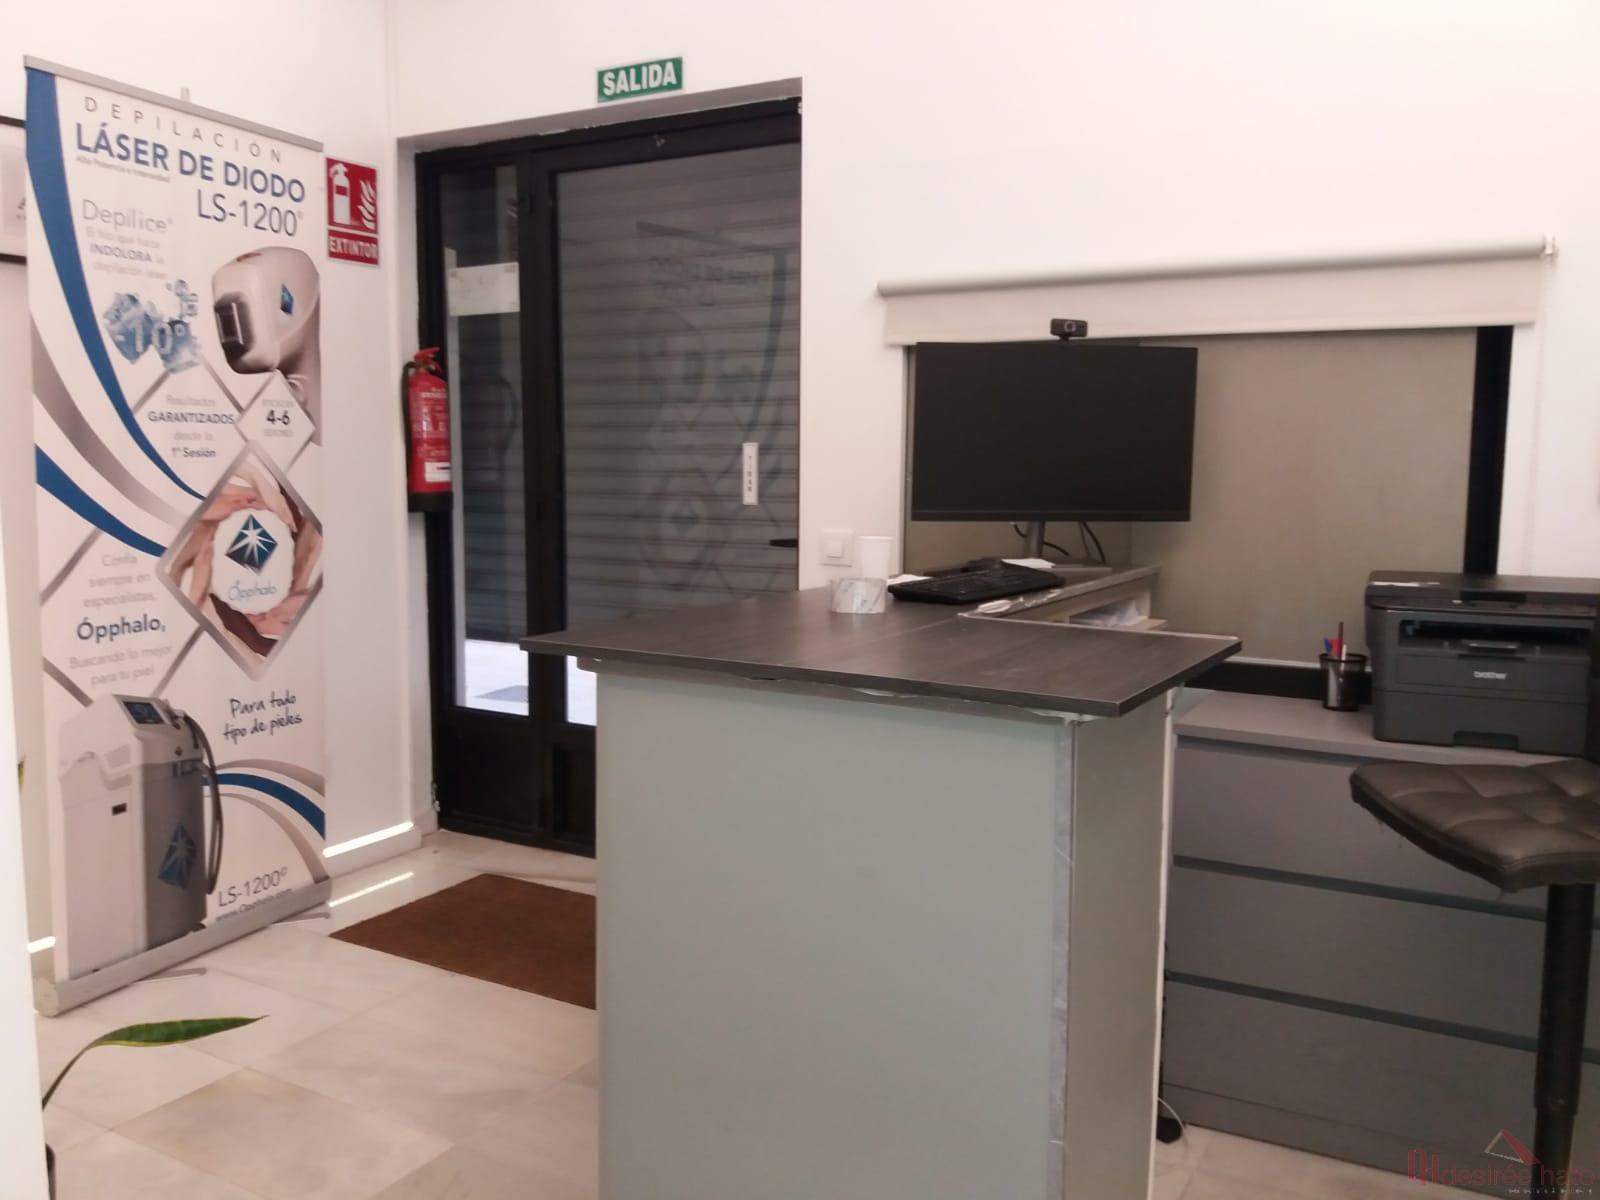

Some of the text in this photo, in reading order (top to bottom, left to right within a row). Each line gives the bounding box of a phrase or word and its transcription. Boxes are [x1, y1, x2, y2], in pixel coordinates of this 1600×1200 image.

[603, 61, 677, 96] SALIDA
[84, 96, 282, 163] DEPILACIÓN
[76, 121, 305, 203] LÁSER DE DIODO
[90, 243, 153, 263] INDOLORA
[329, 235, 378, 259] EXTINTOR
[147, 410, 235, 426] GARANTIZADOS
[266, 409, 291, 427] 4-6
[183, 446, 217, 459] Sesión
[76, 612, 167, 644] Ópphalo,
[229, 690, 297, 719] Para todo
[223, 706, 304, 745] tipo de pieles
